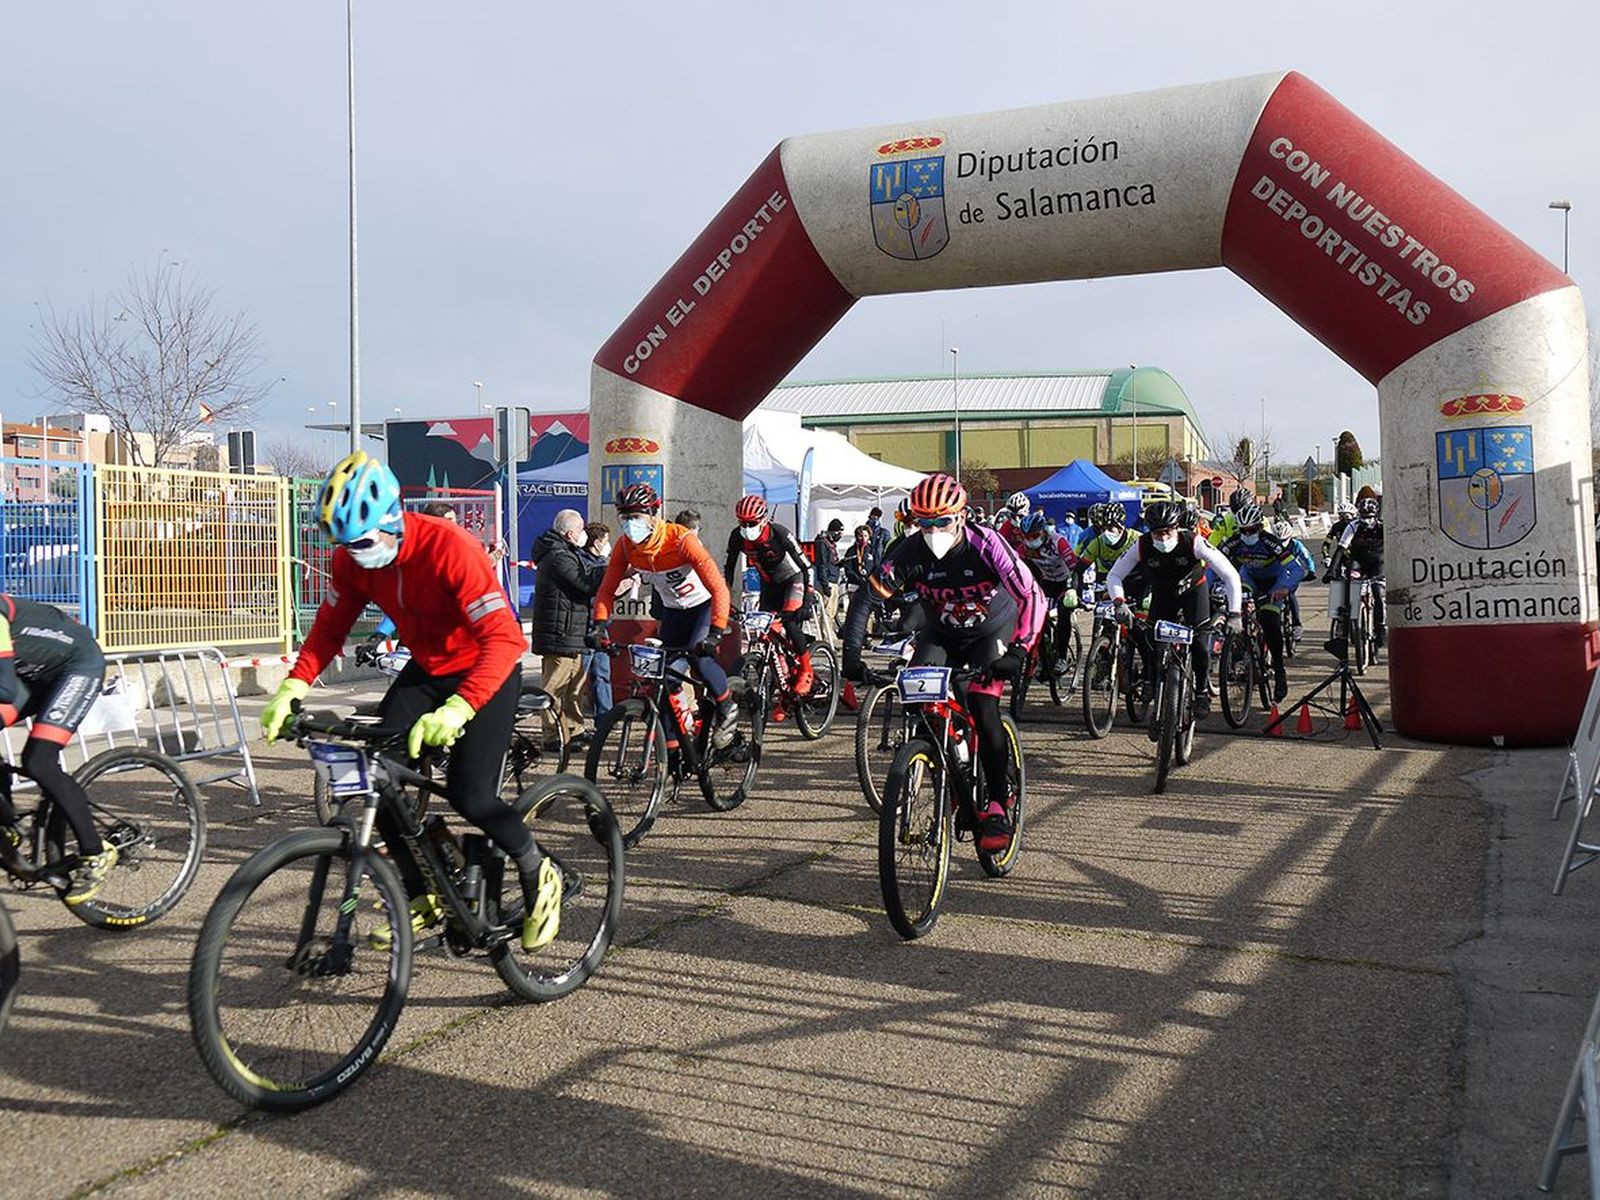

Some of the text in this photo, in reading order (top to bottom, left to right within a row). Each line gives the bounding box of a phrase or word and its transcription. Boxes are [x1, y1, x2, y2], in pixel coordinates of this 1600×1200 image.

[957, 136, 1119, 182] Diputación
[959, 183, 1156, 225] de Salamanca
[1268, 137, 1475, 303] CON NUESTROS
[1251, 175, 1431, 325] DEPORTISTAS
[623, 190, 788, 375] CON EL DEPORTE
[1411, 550, 1566, 588] Diputación
[1404, 592, 1581, 622] de Salamanca
[917, 679, 926, 692] 2
[336, 1045, 374, 1083] BARZO
